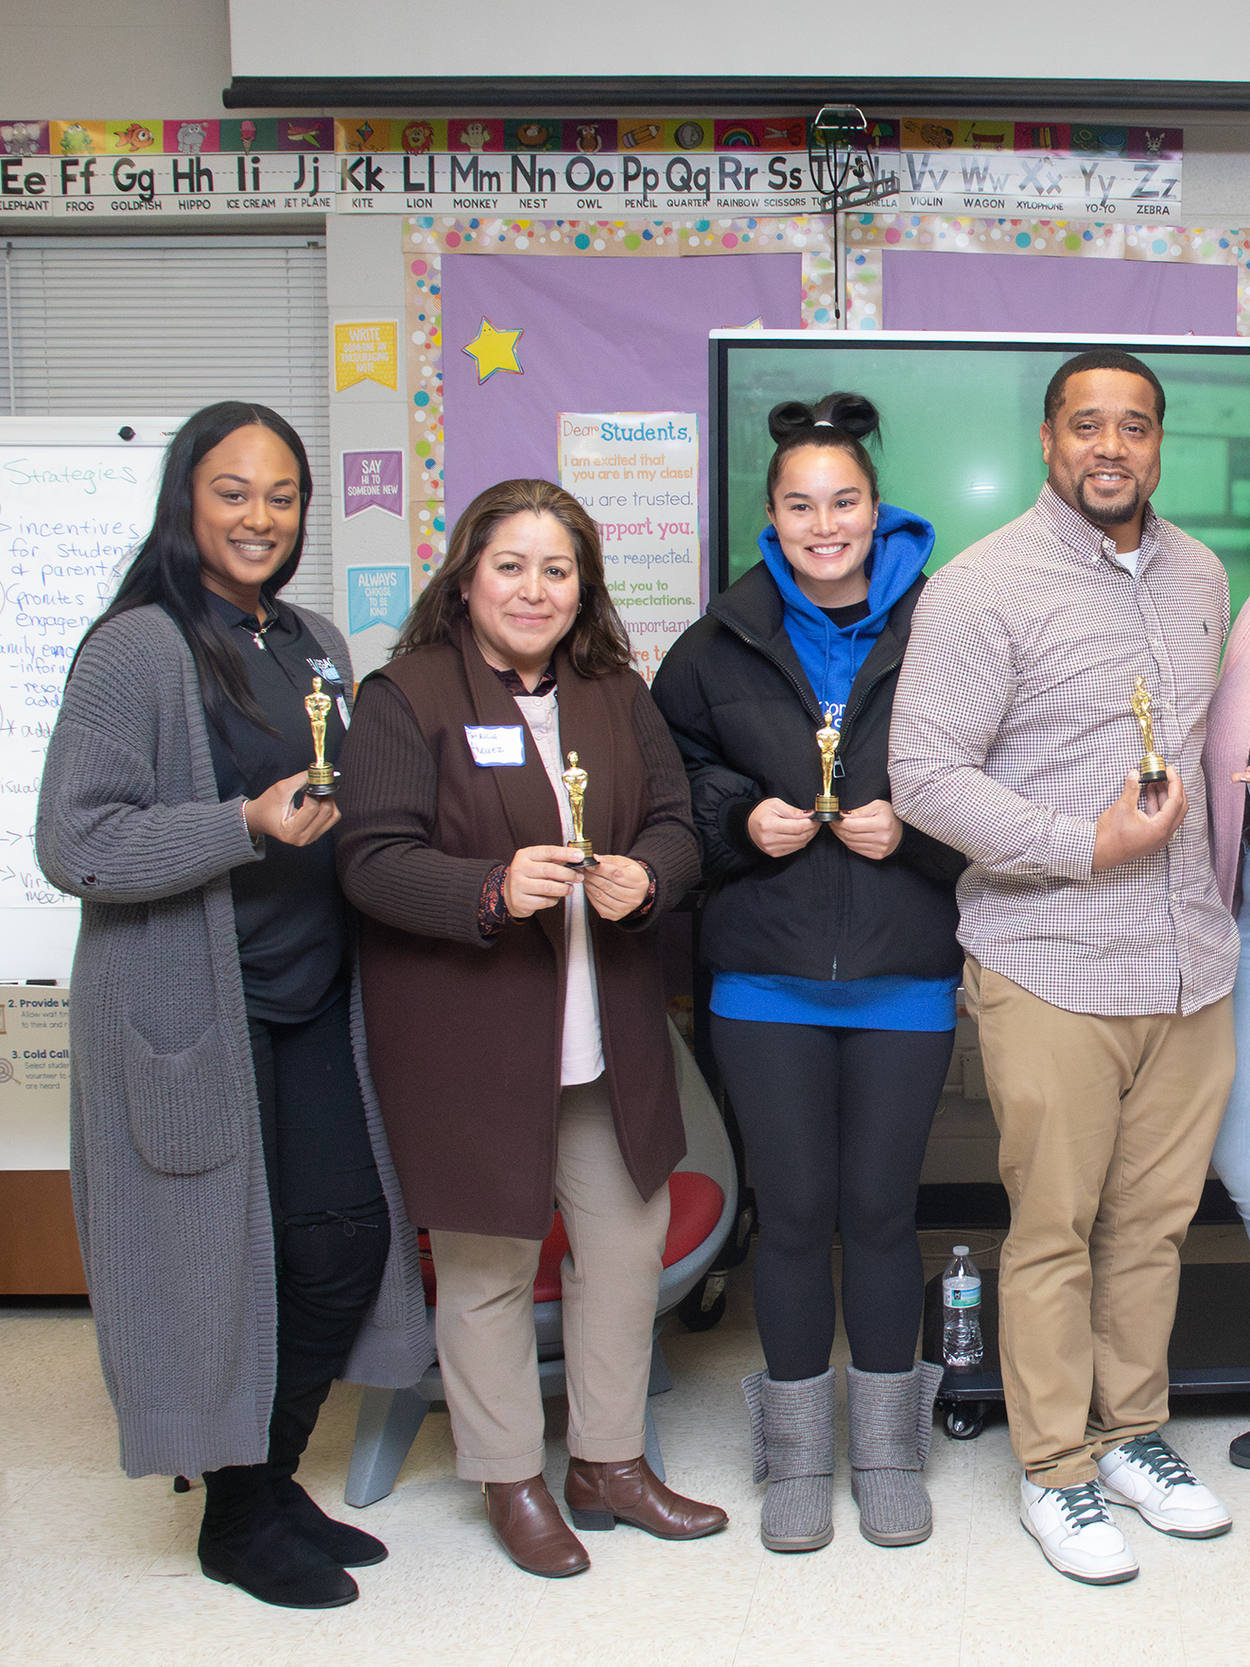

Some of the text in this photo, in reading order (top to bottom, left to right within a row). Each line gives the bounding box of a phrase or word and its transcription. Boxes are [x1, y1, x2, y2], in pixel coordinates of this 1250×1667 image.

[1, 158, 47, 195] Ee
[60, 157, 97, 195] Ff
[112, 157, 155, 202] Gg
[172, 156, 214, 193] Hh
[293, 155, 320, 198] Jj
[340, 156, 385, 192] Kk
[450, 155, 502, 192] Mm
[511, 154, 557, 193] Nn
[565, 155, 614, 192] Oo
[623, 156, 660, 201] Pp
[665, 156, 711, 201] Qq
[718, 155, 759, 191] Rr
[767, 155, 803, 191] Ss
[905, 153, 949, 192] Vv
[960, 156, 1010, 193] Ww
[1018, 158, 1063, 196] Xx
[1079, 161, 1116, 207] Yy
[1131, 163, 1179, 199] Zz
[66, 201, 95, 212] FROG
[111, 200, 163, 211] GOLDFISH
[178, 199, 212, 210] HIPPO
[226, 199, 240, 209] ICE
[243, 198, 276, 209] CREAM
[284, 198, 299, 208] JET
[301, 197, 331, 208] PLANE
[352, 198, 374, 208] KITE
[406, 198, 433, 209] LION
[453, 198, 499, 209] MONKEY
[519, 198, 548, 209] NEST
[576, 199, 603, 209] OWL
[625, 199, 658, 209] PENCIL
[666, 199, 708, 207] QUARTER
[716, 198, 760, 208] RAINBOW
[763, 197, 807, 207] SCISSORS
[910, 196, 943, 207] VIOLIN
[963, 198, 1005, 209] WAGON
[1016, 201, 1064, 211] XYLOPHONE
[1085, 203, 1116, 214] YO-YO
[1136, 204, 1170, 215] ZEBRA
[349, 327, 380, 342] WRITE
[343, 342, 375, 353] SOMEONE
[341, 352, 389, 363] ENCOURAGING
[356, 362, 374, 373] NOTE
[563, 420, 692, 443] Dear Students,
[361, 459, 382, 474] SAY
[570, 457, 590, 467] am
[593, 453, 637, 467] excited
[640, 453, 665, 466] that
[3, 458, 138, 495] Strategies
[361, 474, 381, 485] HI TO
[572, 466, 693, 483] you are in my class!
[347, 484, 398, 497] SOMEONE NEW
[598, 494, 627, 507] are
[632, 491, 694, 507] trusted.
[20, 515, 140, 539] incentives
[657, 522, 694, 540] you.
[8, 537, 39, 558] for
[603, 548, 693, 570] re respected.
[358, 572, 397, 587] ALWAYS
[364, 586, 391, 597] CHOOSE
[606, 580, 669, 594] old you to
[369, 597, 388, 606] TO BE
[611, 595, 695, 609] expectations.
[370, 607, 388, 617] KIND
[633, 650, 650, 662] re
[8, 999, 18, 1008] 2.
[19, 998, 60, 1008] Provide
[21, 1011, 41, 1019] Allow
[21, 1021, 29, 1029] to
[31, 1021, 48, 1029] think
[49, 1021, 63, 1029] and
[12, 1049, 69, 1059] 3. Cold Call
[24, 1061, 46, 1070] Select
[25, 1072, 67, 1080] volunteer to
